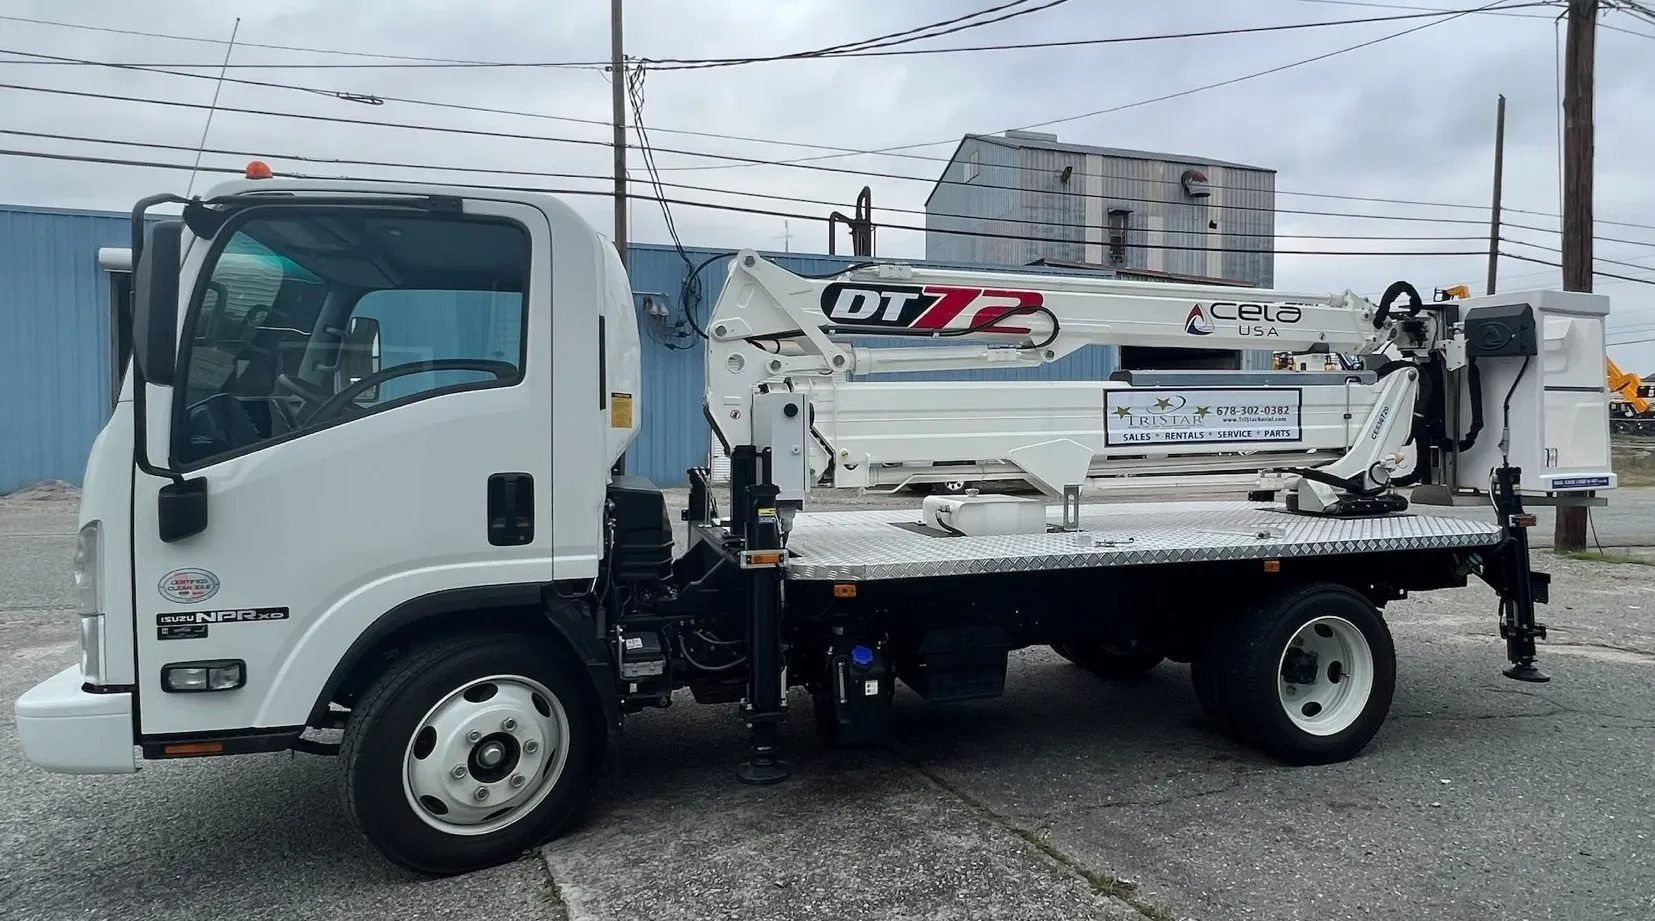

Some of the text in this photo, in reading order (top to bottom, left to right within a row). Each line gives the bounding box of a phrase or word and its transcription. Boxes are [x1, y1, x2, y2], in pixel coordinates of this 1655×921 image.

[1238, 325, 1279, 337] USA
[1216, 405, 1290, 416] 678-302-0382
[1123, 429, 1291, 442] SALES RENTALS SERVICE PARTS
[160, 615, 194, 623] ISUZU
[195, 610, 256, 623] NPR
